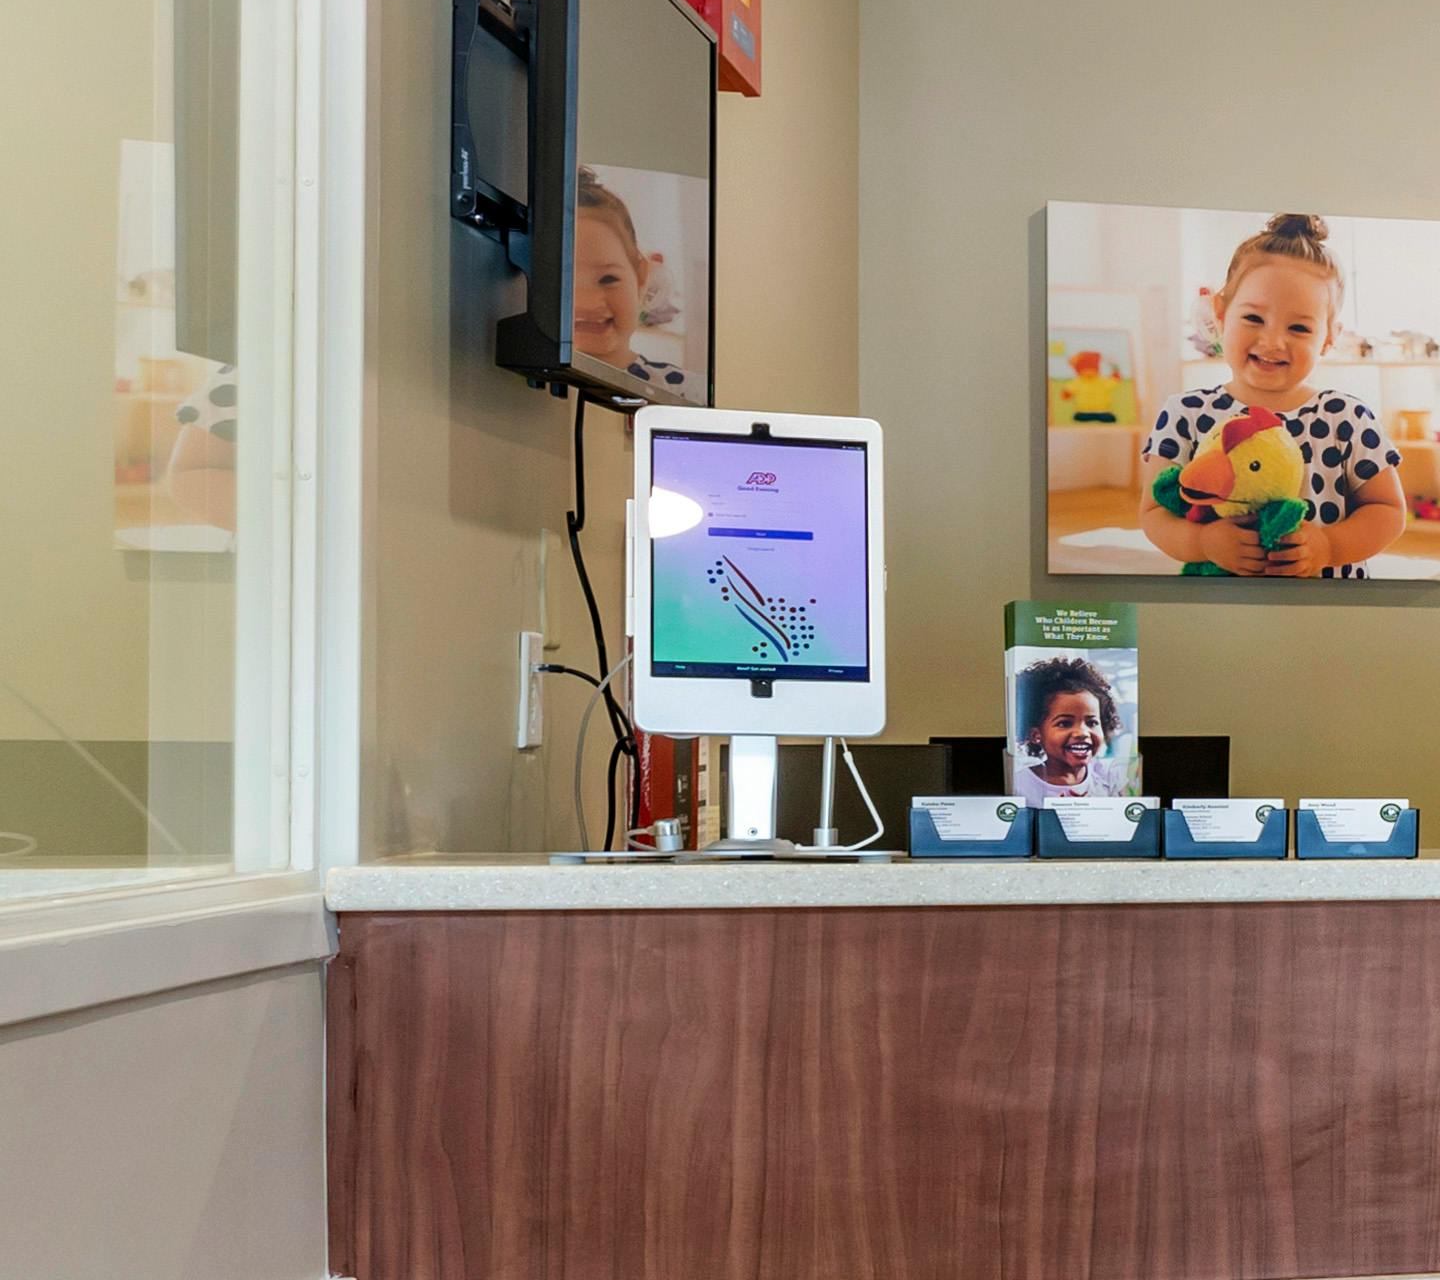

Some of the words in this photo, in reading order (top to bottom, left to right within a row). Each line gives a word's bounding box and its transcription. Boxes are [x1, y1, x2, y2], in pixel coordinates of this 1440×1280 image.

[745, 472, 777, 485] ADP
[1056, 609, 1068, 617] We
[1070, 609, 1098, 617] Believe
[1044, 632, 1064, 640] What
[1066, 633, 1085, 641] They
